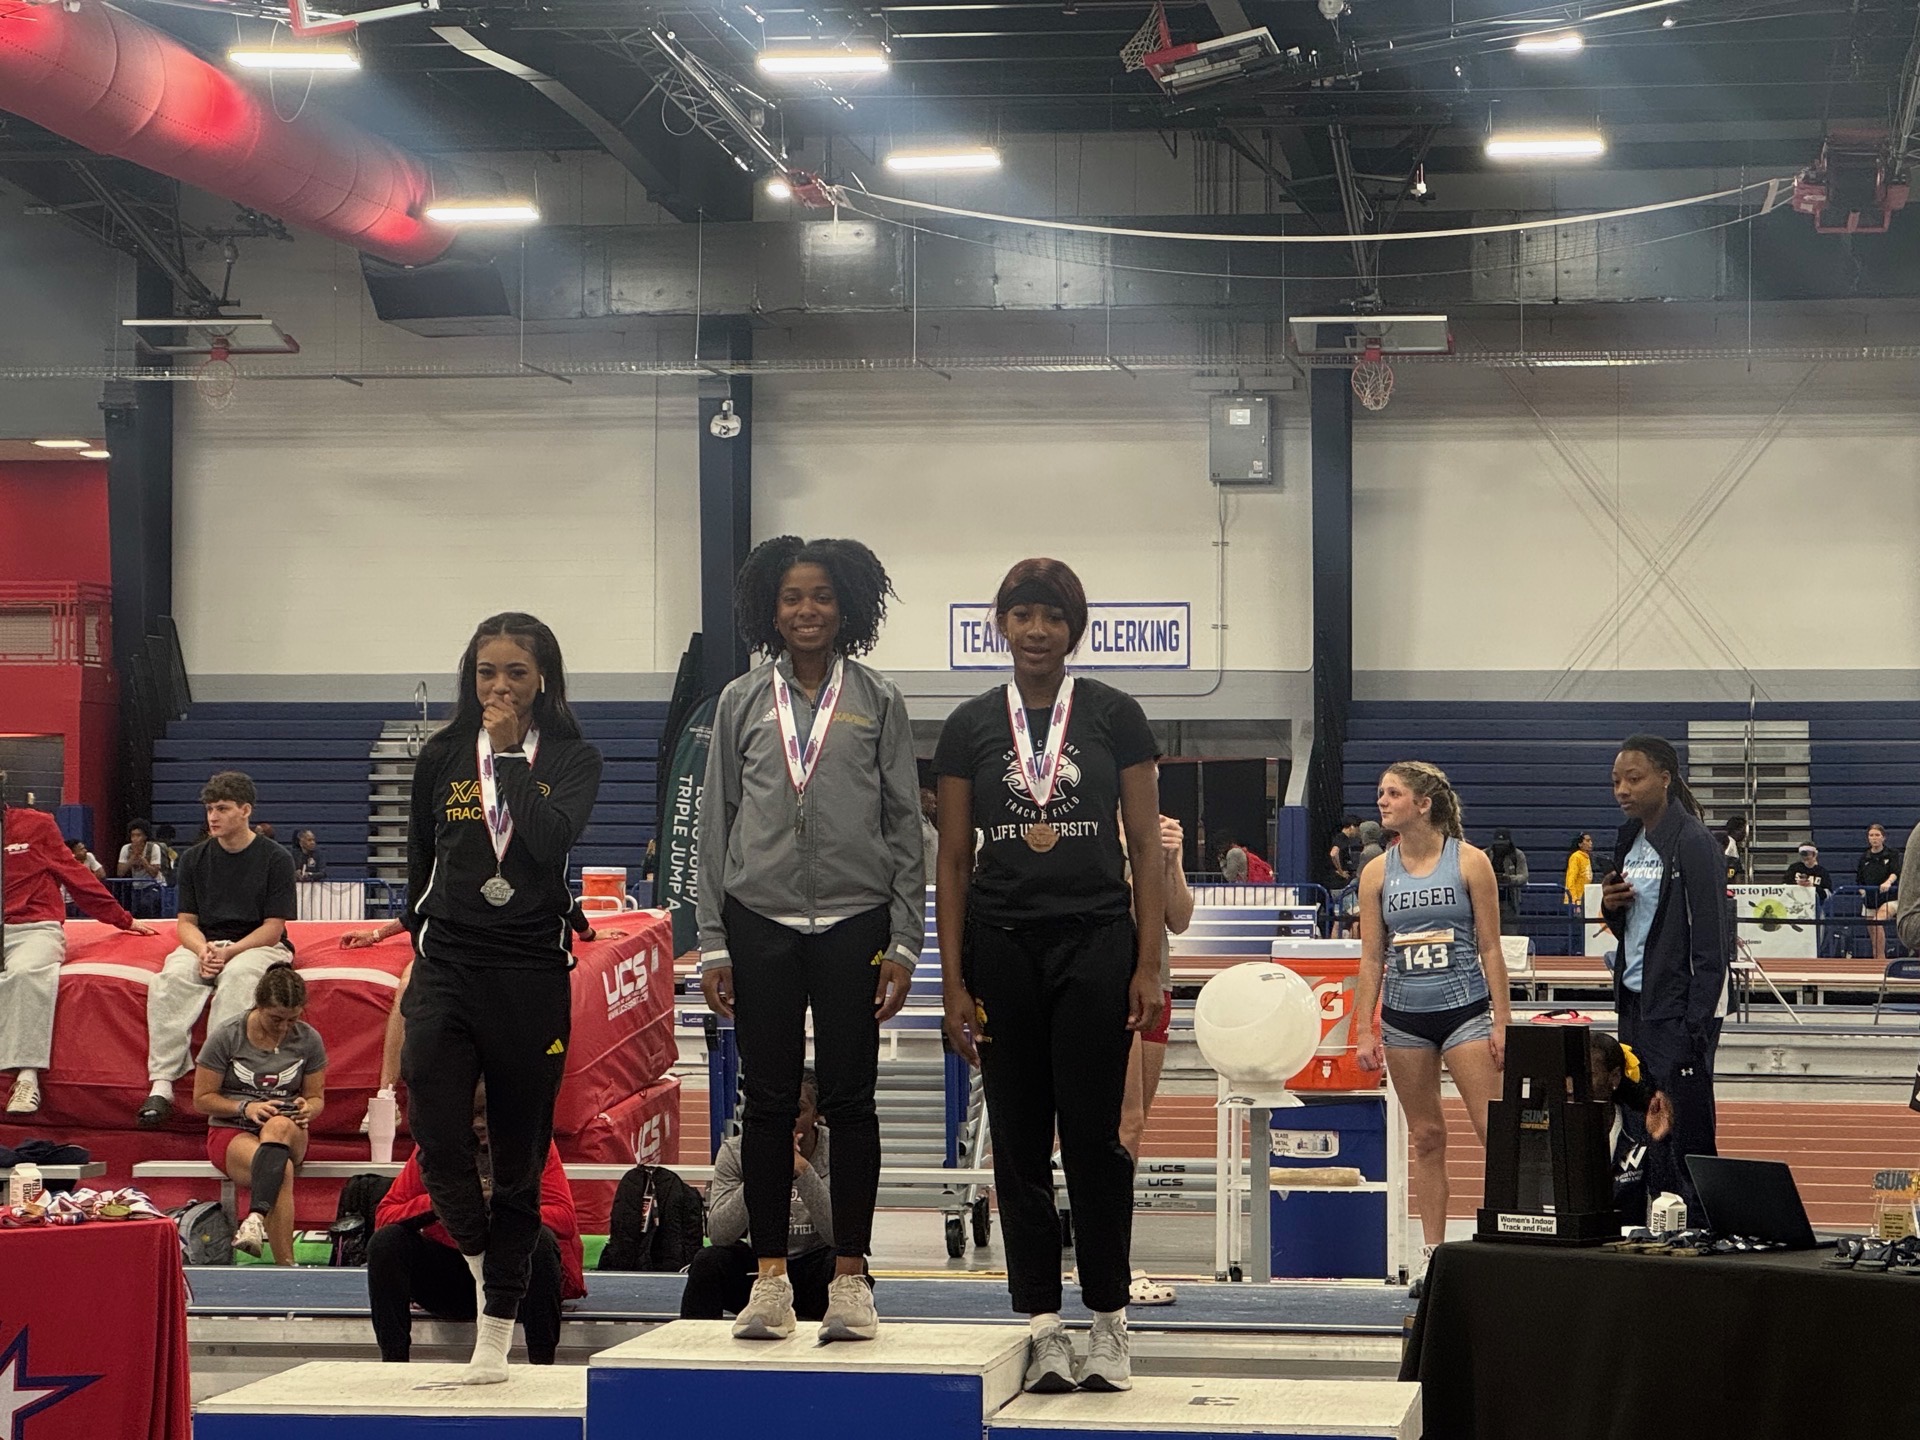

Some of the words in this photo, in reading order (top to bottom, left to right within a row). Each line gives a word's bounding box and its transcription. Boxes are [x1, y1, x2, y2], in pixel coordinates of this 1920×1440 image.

[1091, 620, 1180, 652] CLERKING
[445, 806, 485, 822] TRAC
[672, 774, 693, 837] TRIPLE
[1004, 798, 1037, 819] TRACK
[1052, 795, 1080, 817] FIELD
[990, 824, 1017, 842] LIFE
[668, 840, 687, 894] JUMP
[1795, 872, 1822, 886] SAD
[1387, 886, 1457, 913] KEISER
[1748, 887, 1759, 895] to
[1761, 886, 1785, 897] play
[665, 897, 682, 911] A
[1403, 943, 1449, 971] 143
[602, 949, 648, 1006] UCS
[1311, 982, 1344, 1020] G
[1149, 1164, 1186, 1173] UCS
[1147, 1178, 1184, 1187] UCS
[1500, 1216, 1530, 1224] Women's
[1531, 1217, 1555, 1225] Indoor
[1502, 1223, 1521, 1231] Track
[1536, 1225, 1553, 1233] Field
